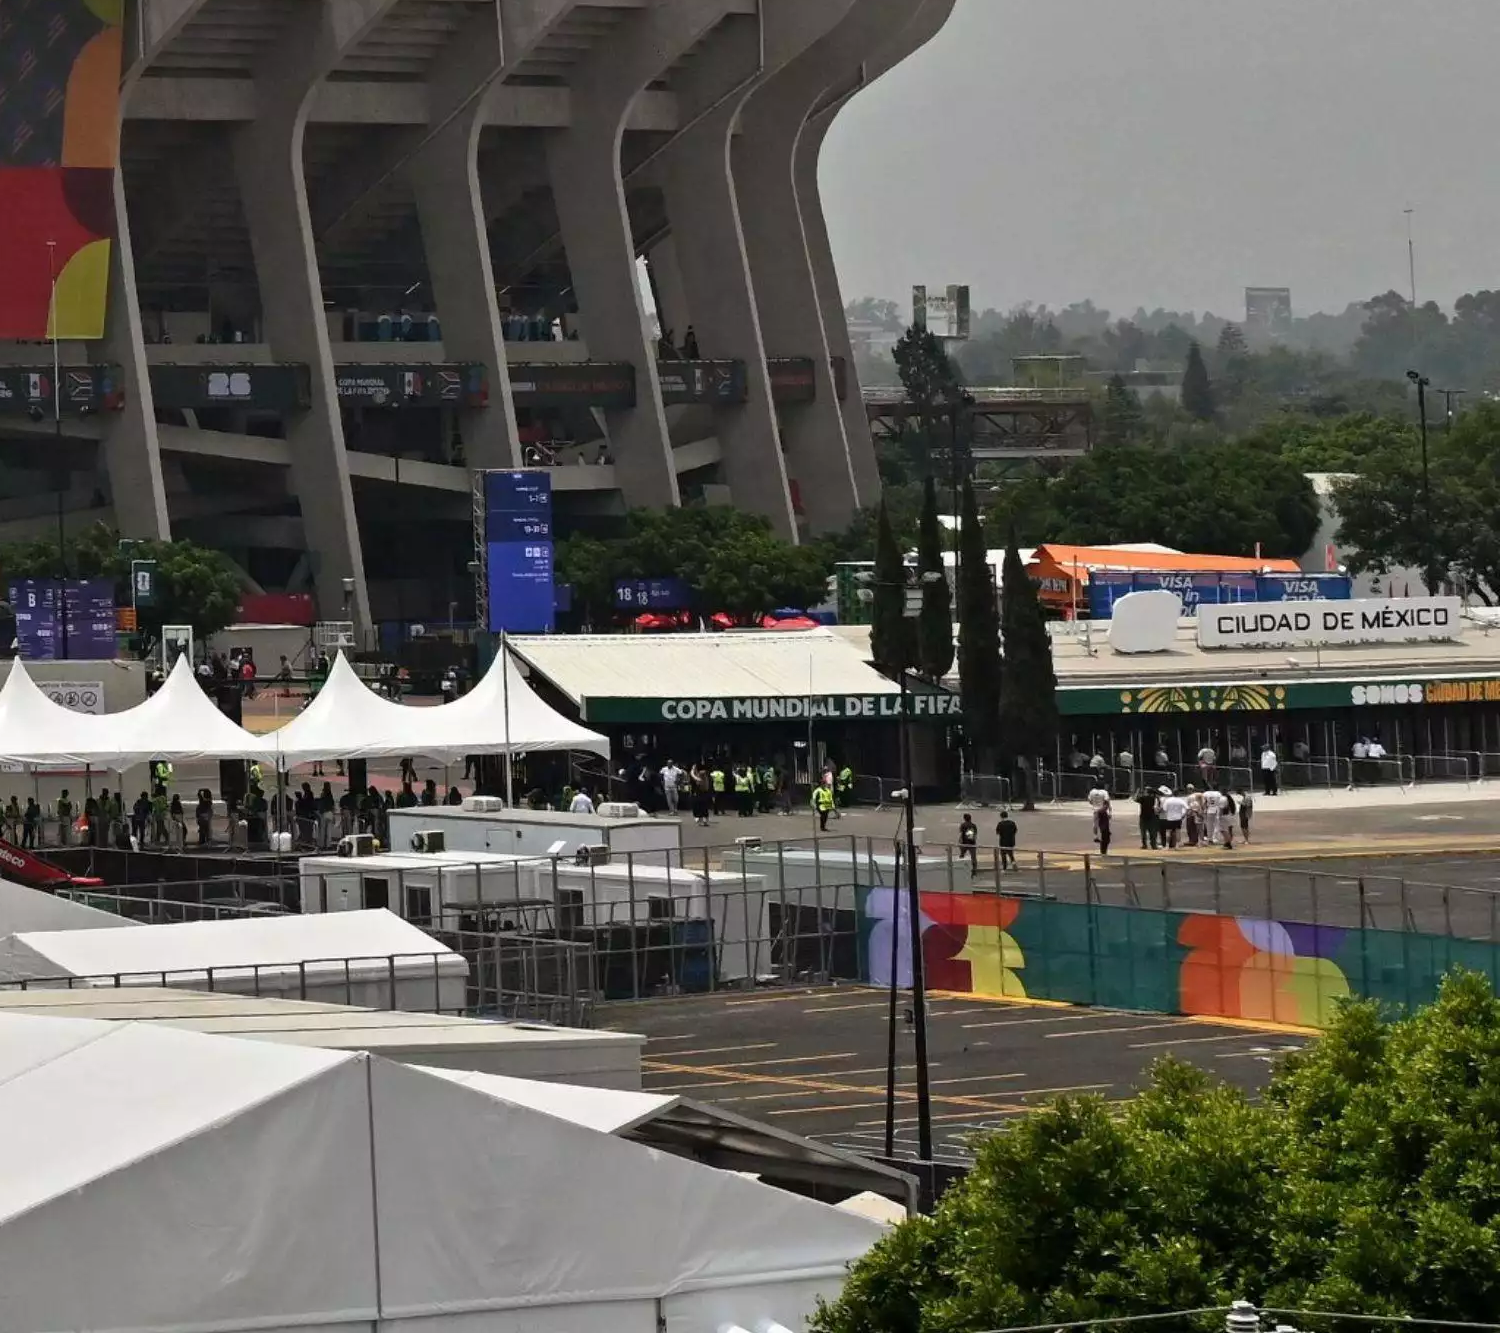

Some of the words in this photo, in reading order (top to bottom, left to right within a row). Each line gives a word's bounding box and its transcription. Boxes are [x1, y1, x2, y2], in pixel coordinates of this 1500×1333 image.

[1159, 576, 1193, 589] VISA
[1284, 581, 1319, 593] VISA
[617, 587, 632, 602] 18
[1217, 613, 1310, 634] CIUDAD
[1323, 612, 1354, 630] DE
[1361, 606, 1449, 629] MÉXICO
[1351, 684, 1424, 705] SOMOS
[661, 698, 729, 721] COPA
[733, 696, 841, 720] MUNDIAL
[845, 695, 876, 717] DE
[879, 695, 908, 716] LA
[914, 695, 963, 715] FIFA
